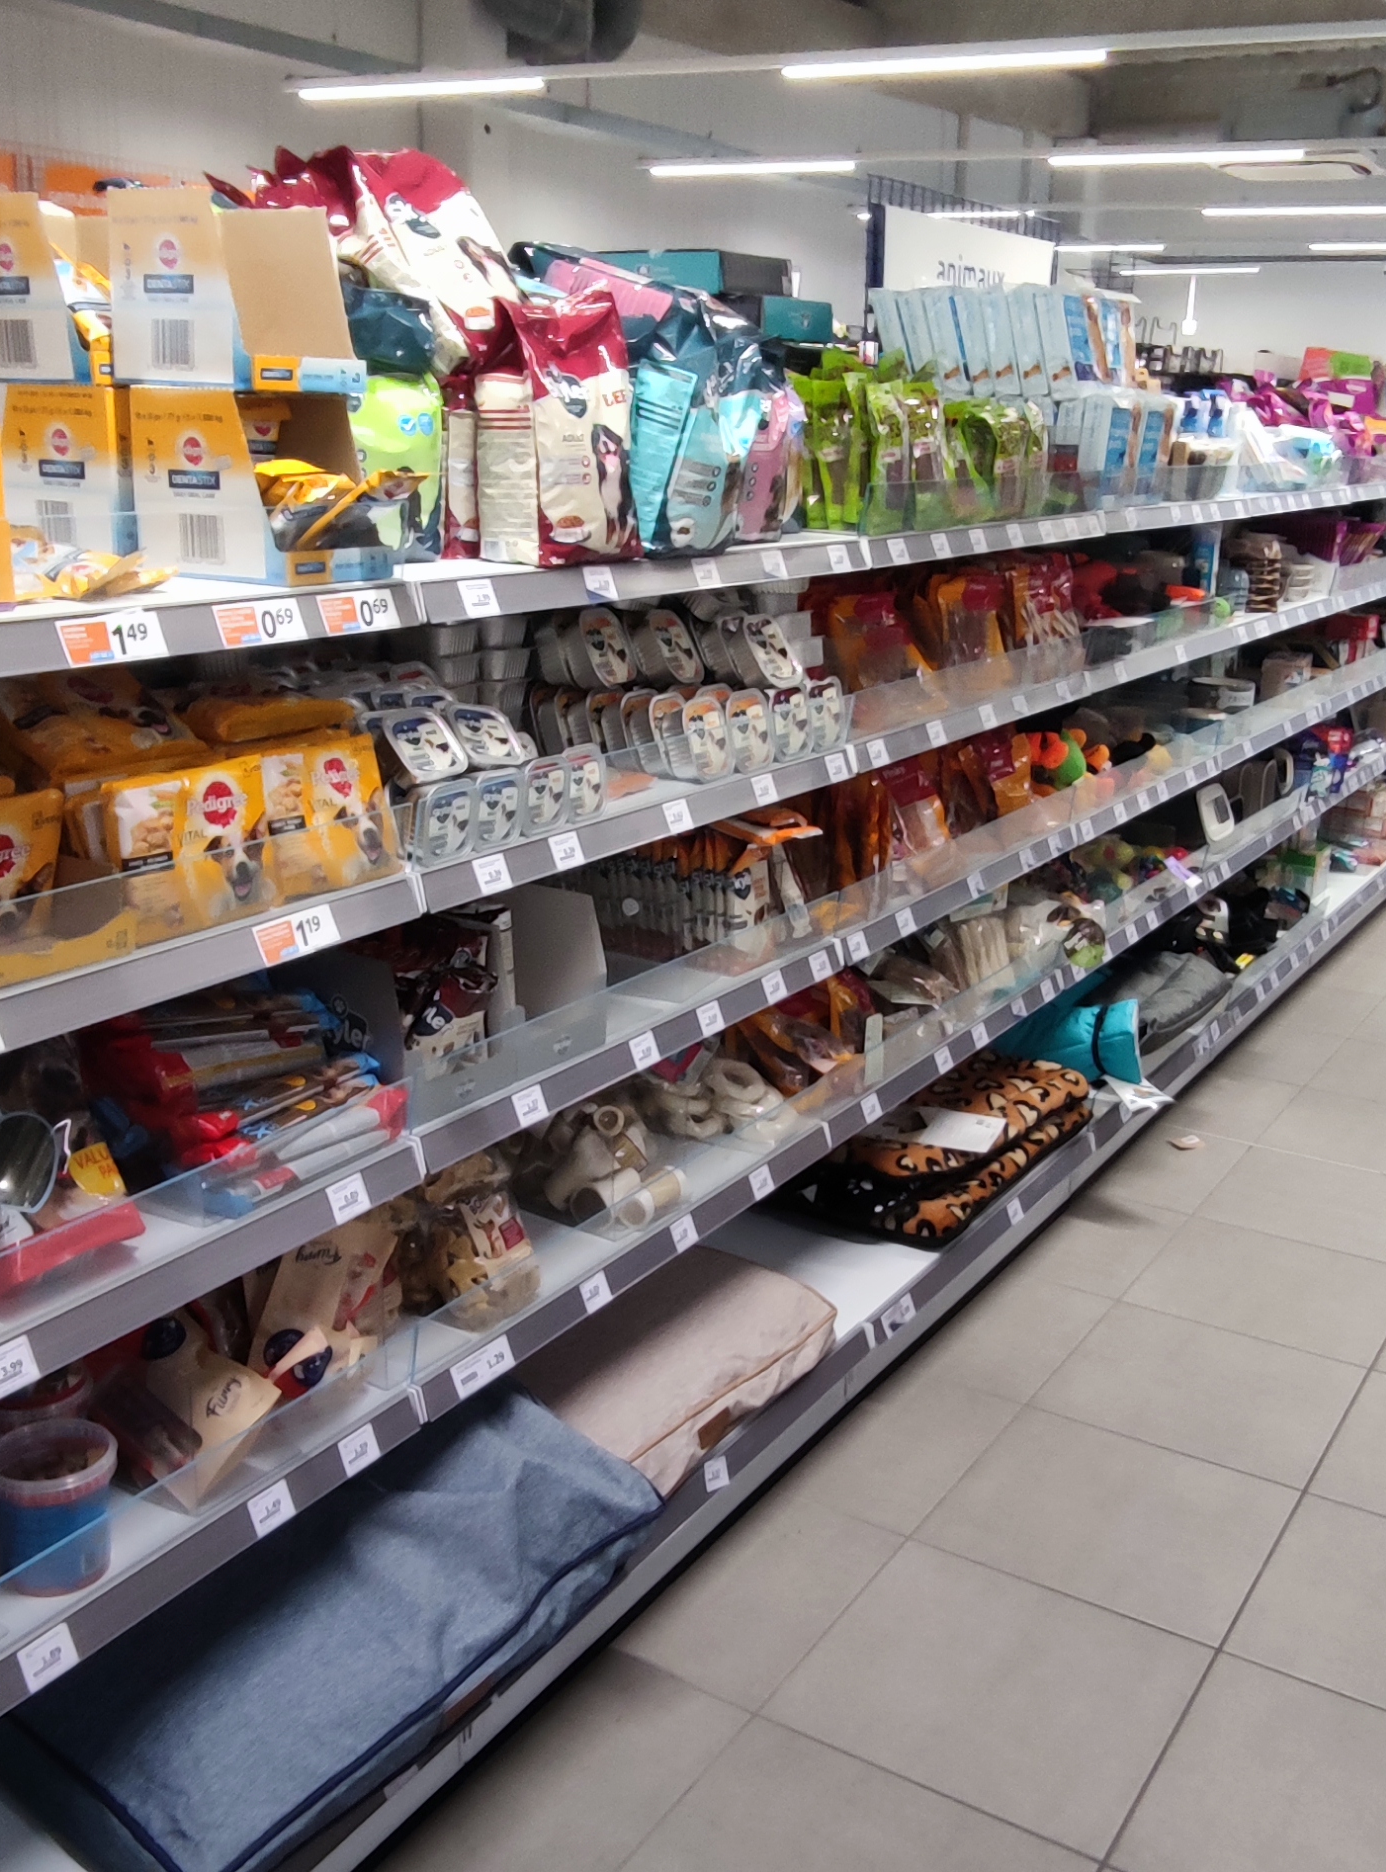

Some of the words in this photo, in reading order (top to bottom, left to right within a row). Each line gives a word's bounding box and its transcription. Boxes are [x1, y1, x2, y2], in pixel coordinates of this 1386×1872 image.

[936, 253, 1004, 288] animaux
[177, 829, 208, 845] VITAL
[74, 1149, 110, 1170] VALU
